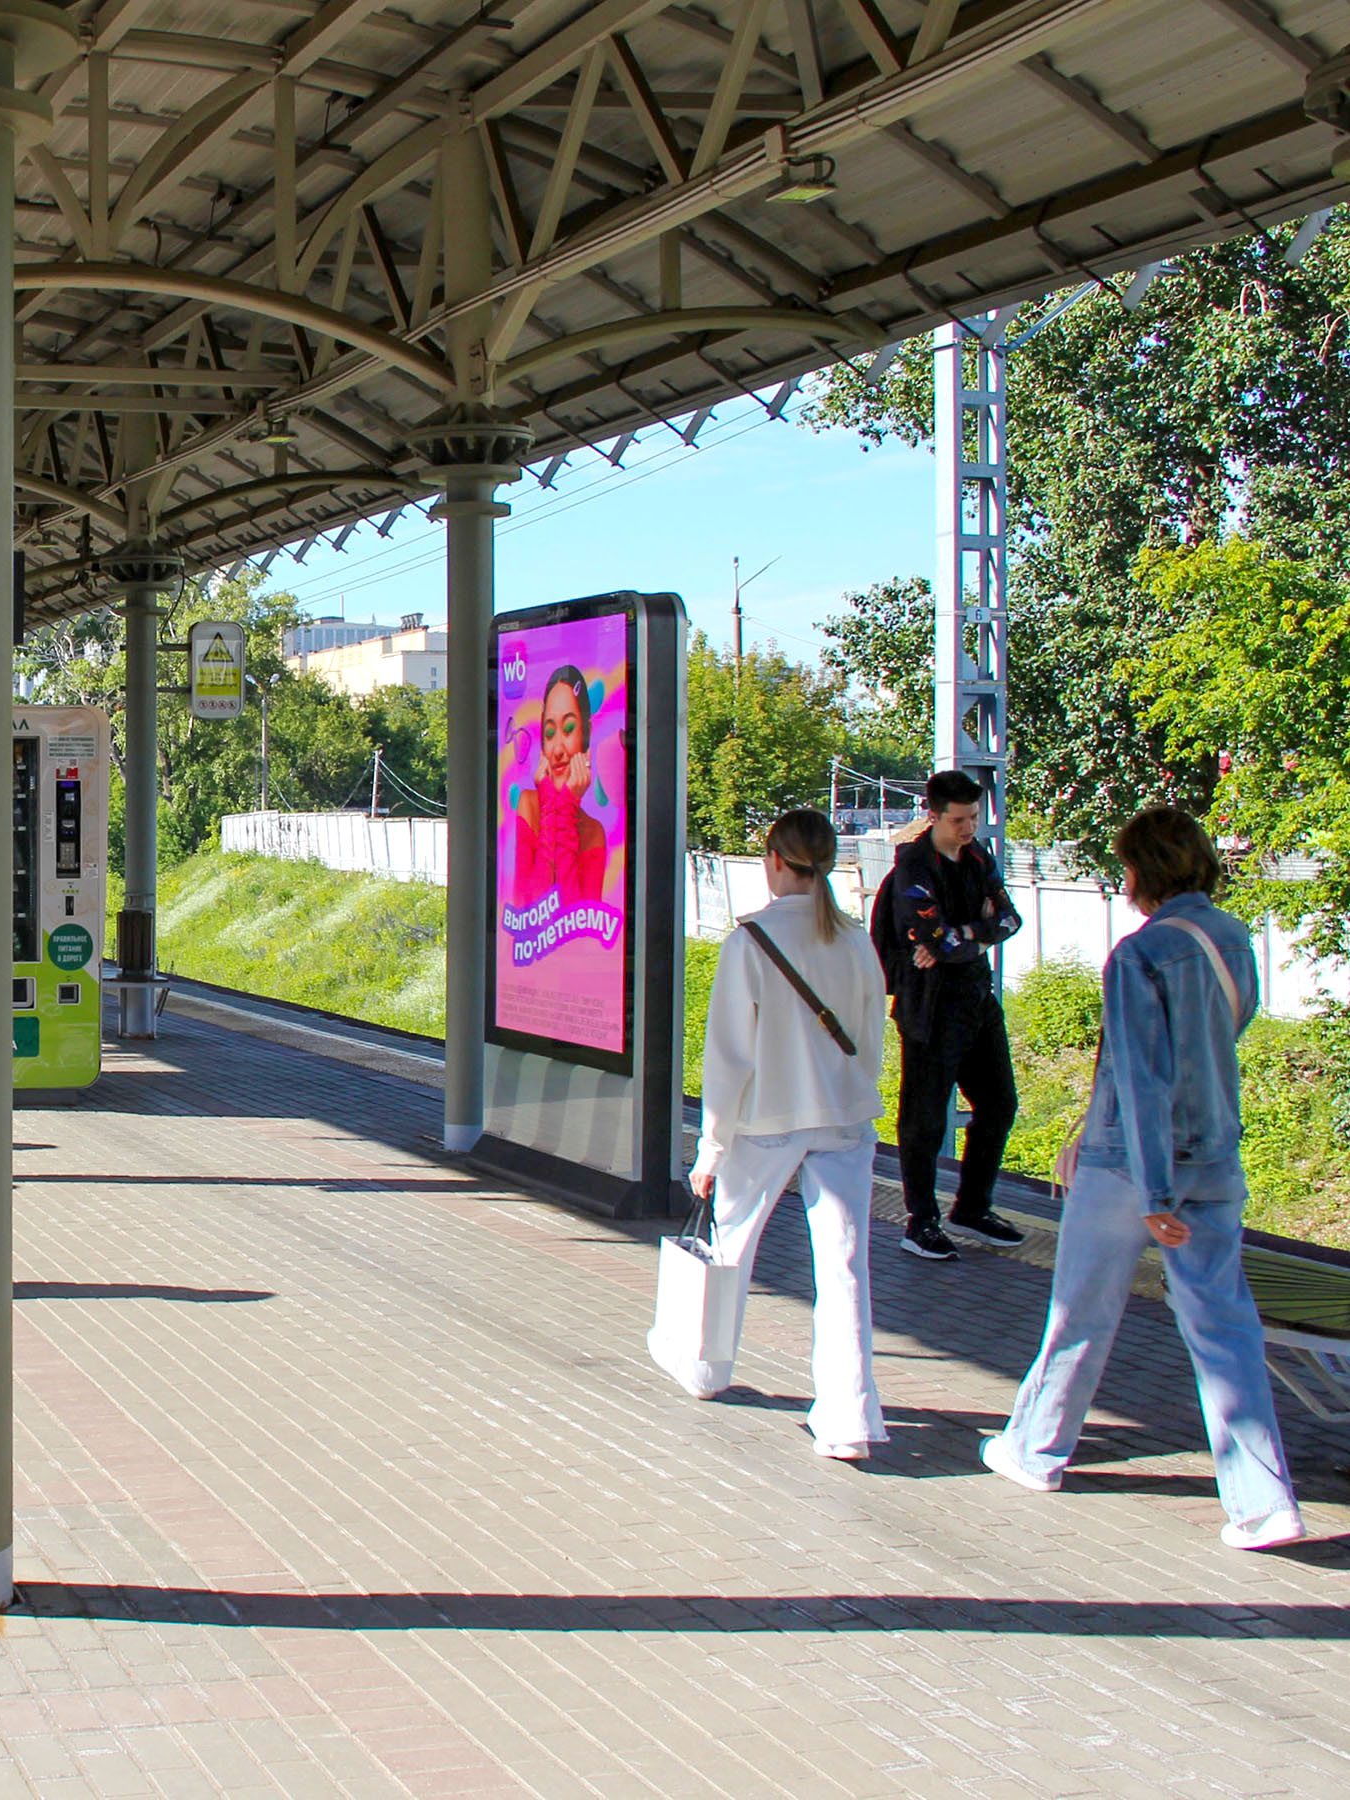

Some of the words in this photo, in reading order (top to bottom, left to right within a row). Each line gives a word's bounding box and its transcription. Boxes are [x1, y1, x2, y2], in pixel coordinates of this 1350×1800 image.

[503, 652, 526, 682] wb
[503, 890, 560, 931] выгода
[514, 908, 619, 961] по-летнему
